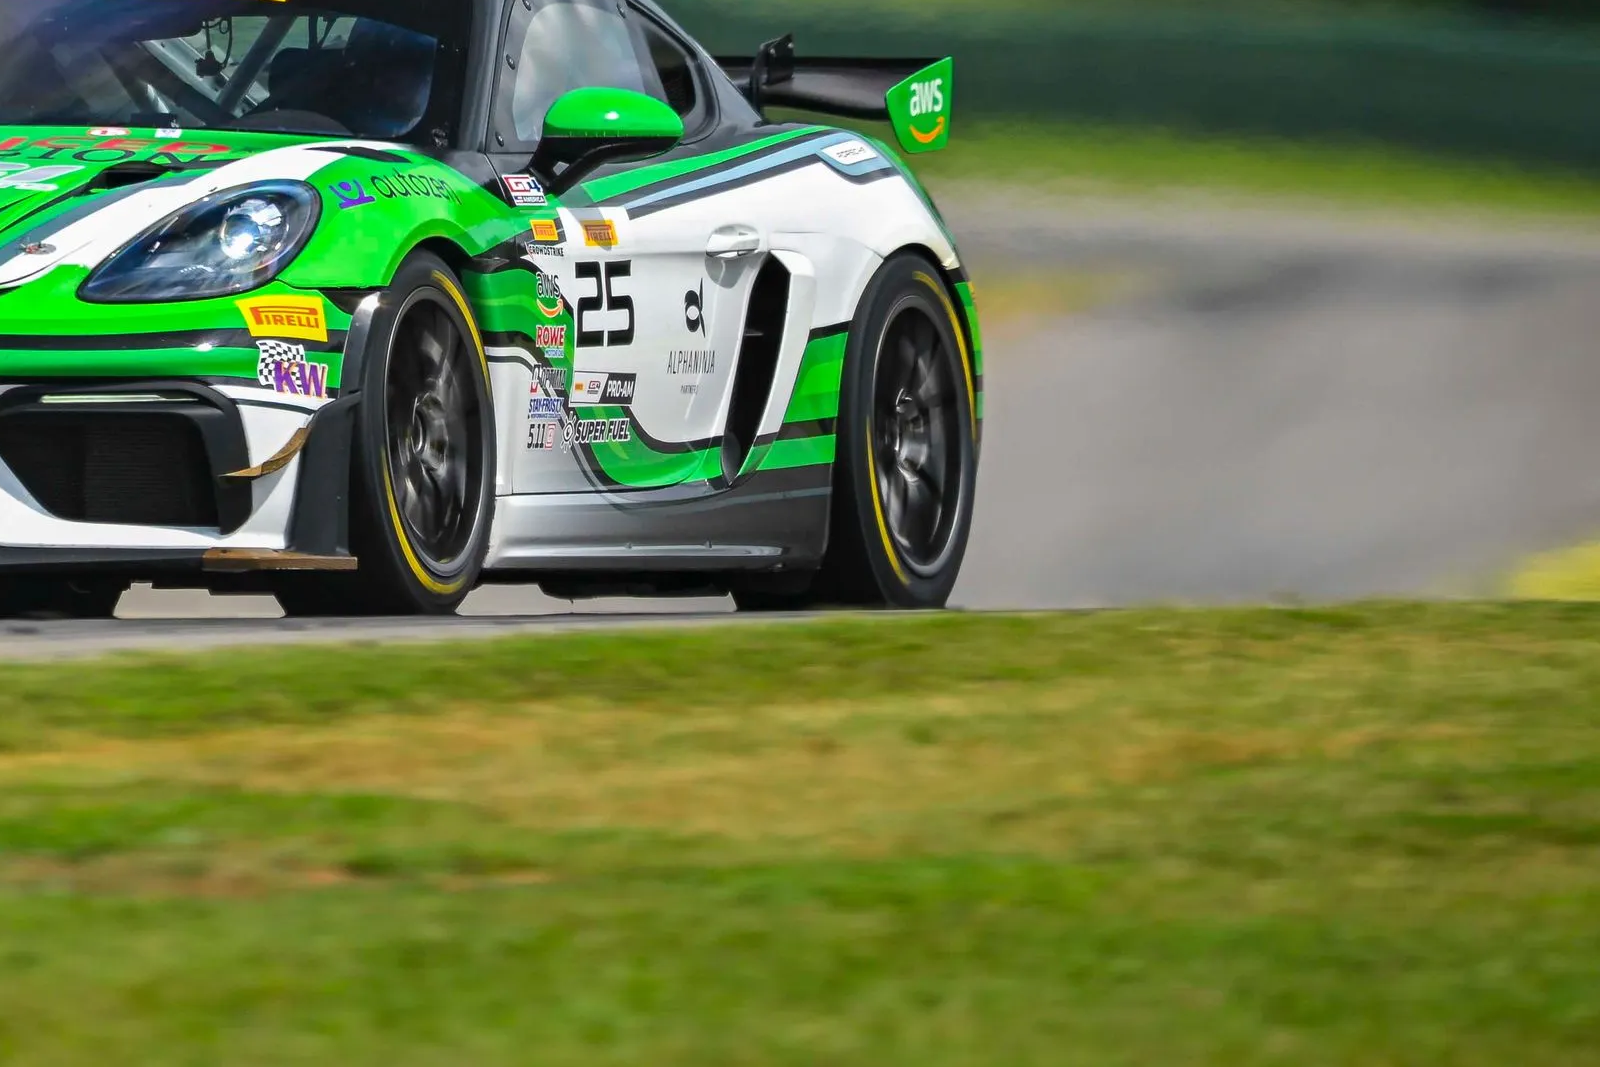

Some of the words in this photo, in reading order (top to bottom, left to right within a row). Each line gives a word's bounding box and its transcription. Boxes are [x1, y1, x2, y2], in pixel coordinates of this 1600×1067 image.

[909, 78, 944, 117] aws
[370, 167, 463, 206] autozen
[503, 176, 541, 193] GT4
[528, 243, 564, 257] CROWDSTRIKE
[535, 271, 561, 299] aws
[574, 260, 635, 348] 25
[249, 305, 320, 329] PIRELLI
[535, 324, 565, 347] ROWE
[666, 350, 716, 374] ALPHANINJA
[273, 360, 328, 400] KW
[606, 380, 635, 397] PRO-AM
[526, 423, 546, 449] 5.11
[574, 419, 606, 443] SUPER
[607, 418, 631, 442] FUEL
